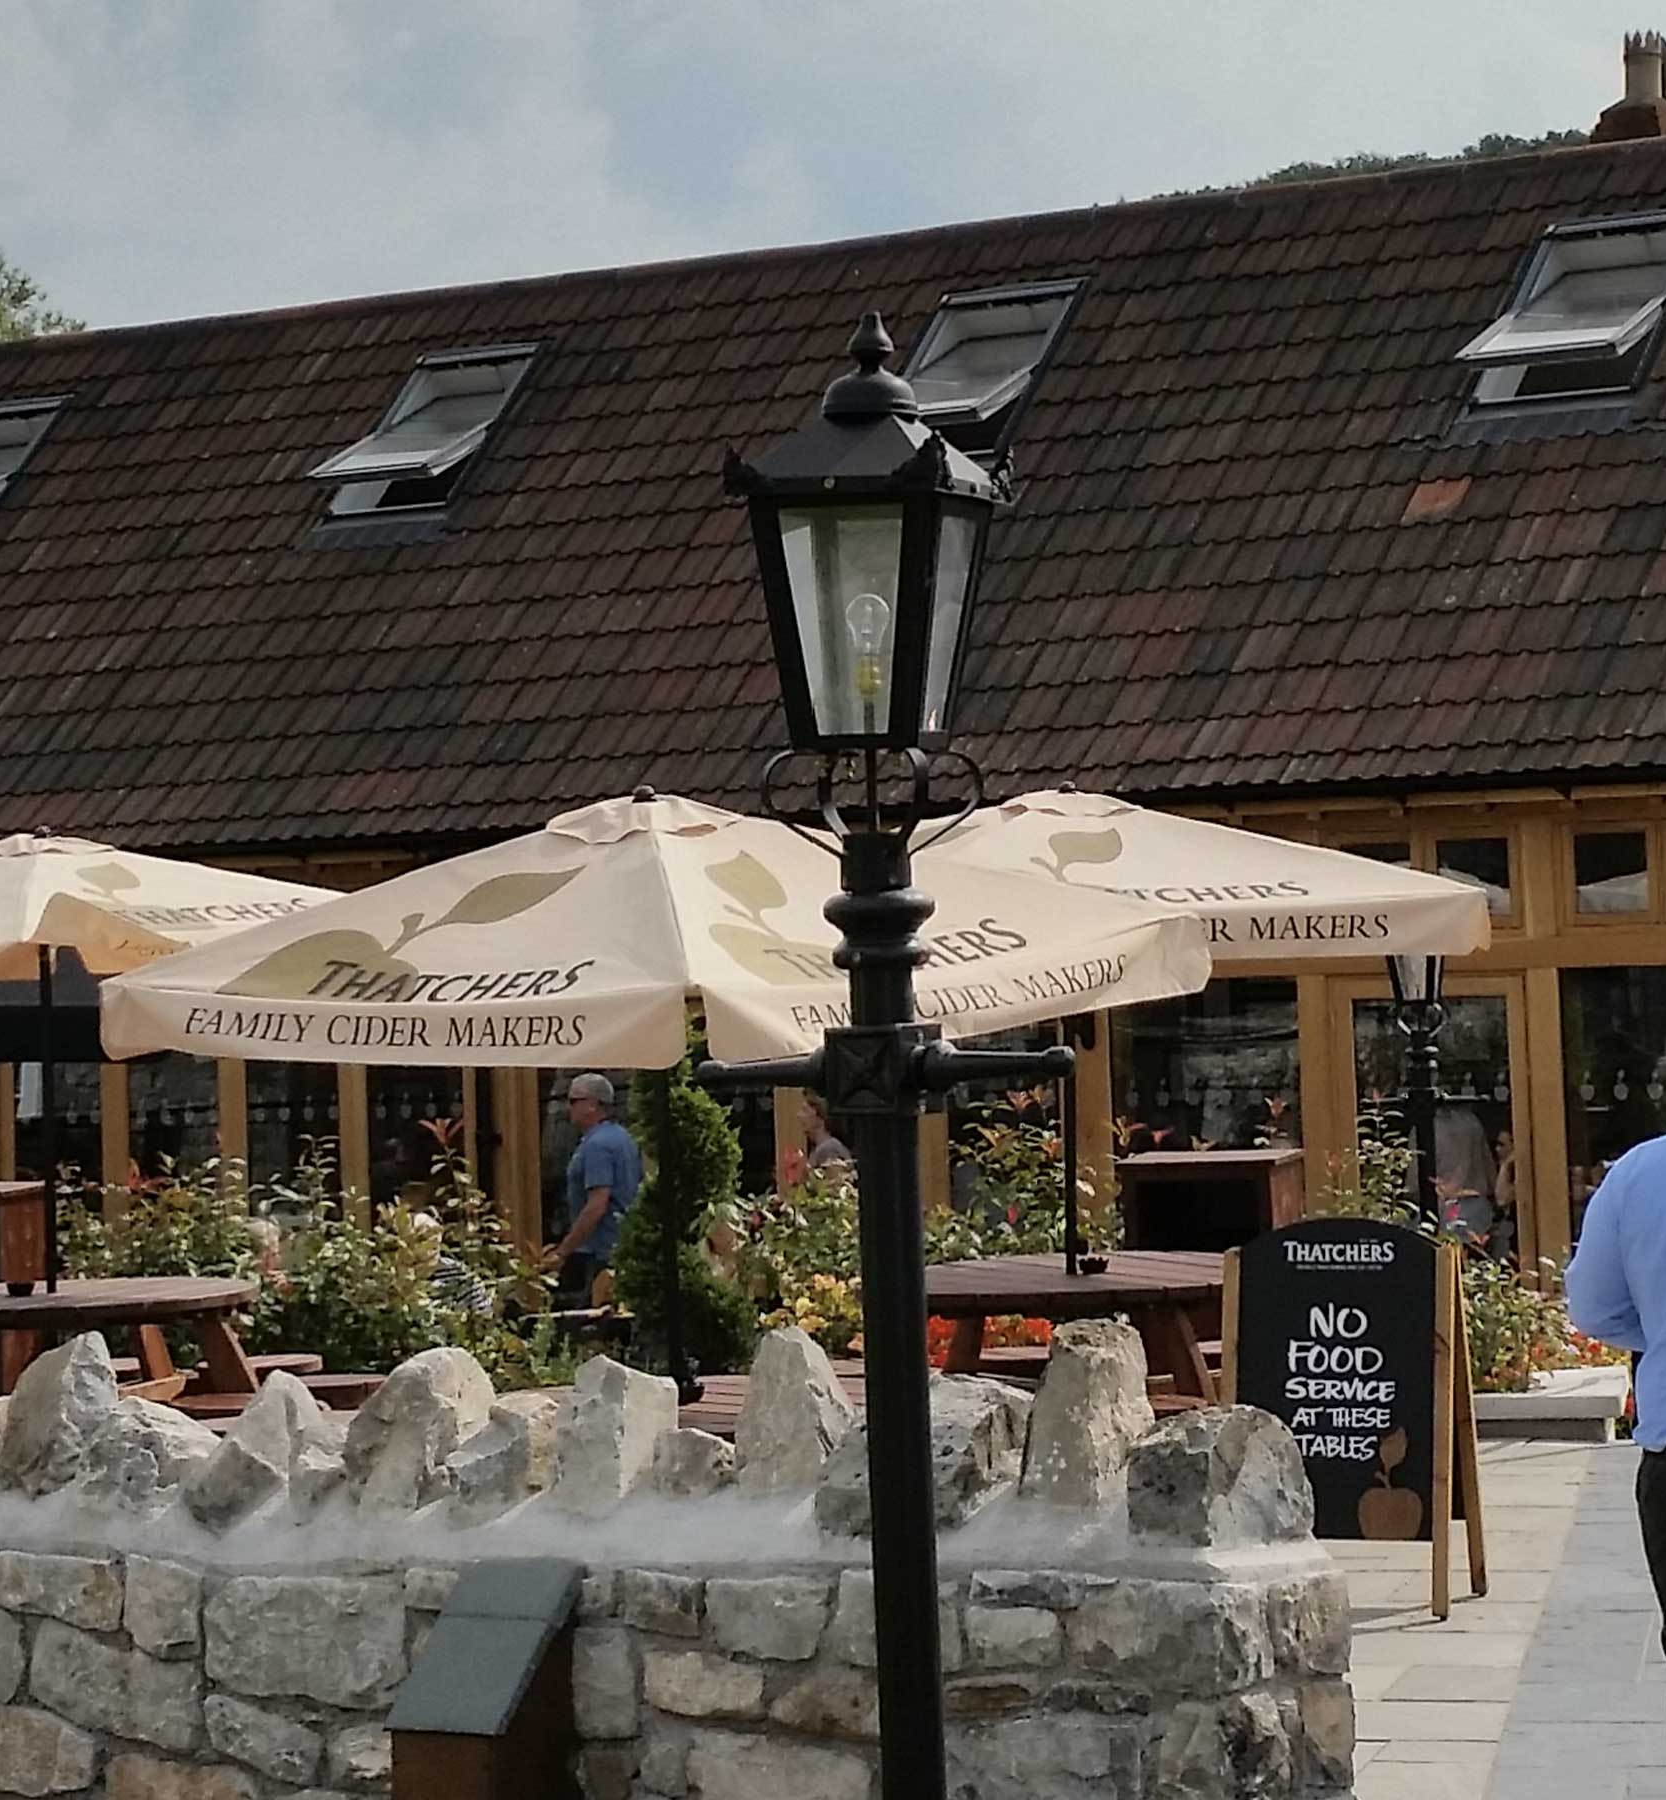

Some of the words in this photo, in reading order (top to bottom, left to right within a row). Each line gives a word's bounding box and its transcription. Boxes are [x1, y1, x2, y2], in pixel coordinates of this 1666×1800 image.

[1104, 880, 1310, 903] TCHERS
[1249, 914, 1389, 940] MAKERS
[307, 958, 595, 1003] THATCHERS
[790, 1001, 852, 1033] FAM
[915, 983, 1015, 1020] CIDER
[1013, 953, 1128, 1003] MAKERS
[184, 1007, 316, 1043] FAMILY
[325, 1014, 432, 1047] CIDER
[444, 1015, 587, 1048] MAKERS
[1282, 1240, 1395, 1263] THATCHERS
[1308, 1301, 1369, 1339] NO
[1287, 1338, 1384, 1375] FOOD
[1284, 1376, 1397, 1403] SERVICE
[1290, 1406, 1325, 1429] AT
[1325, 1406, 1392, 1429] THESE
[1293, 1433, 1379, 1462] TABLES
